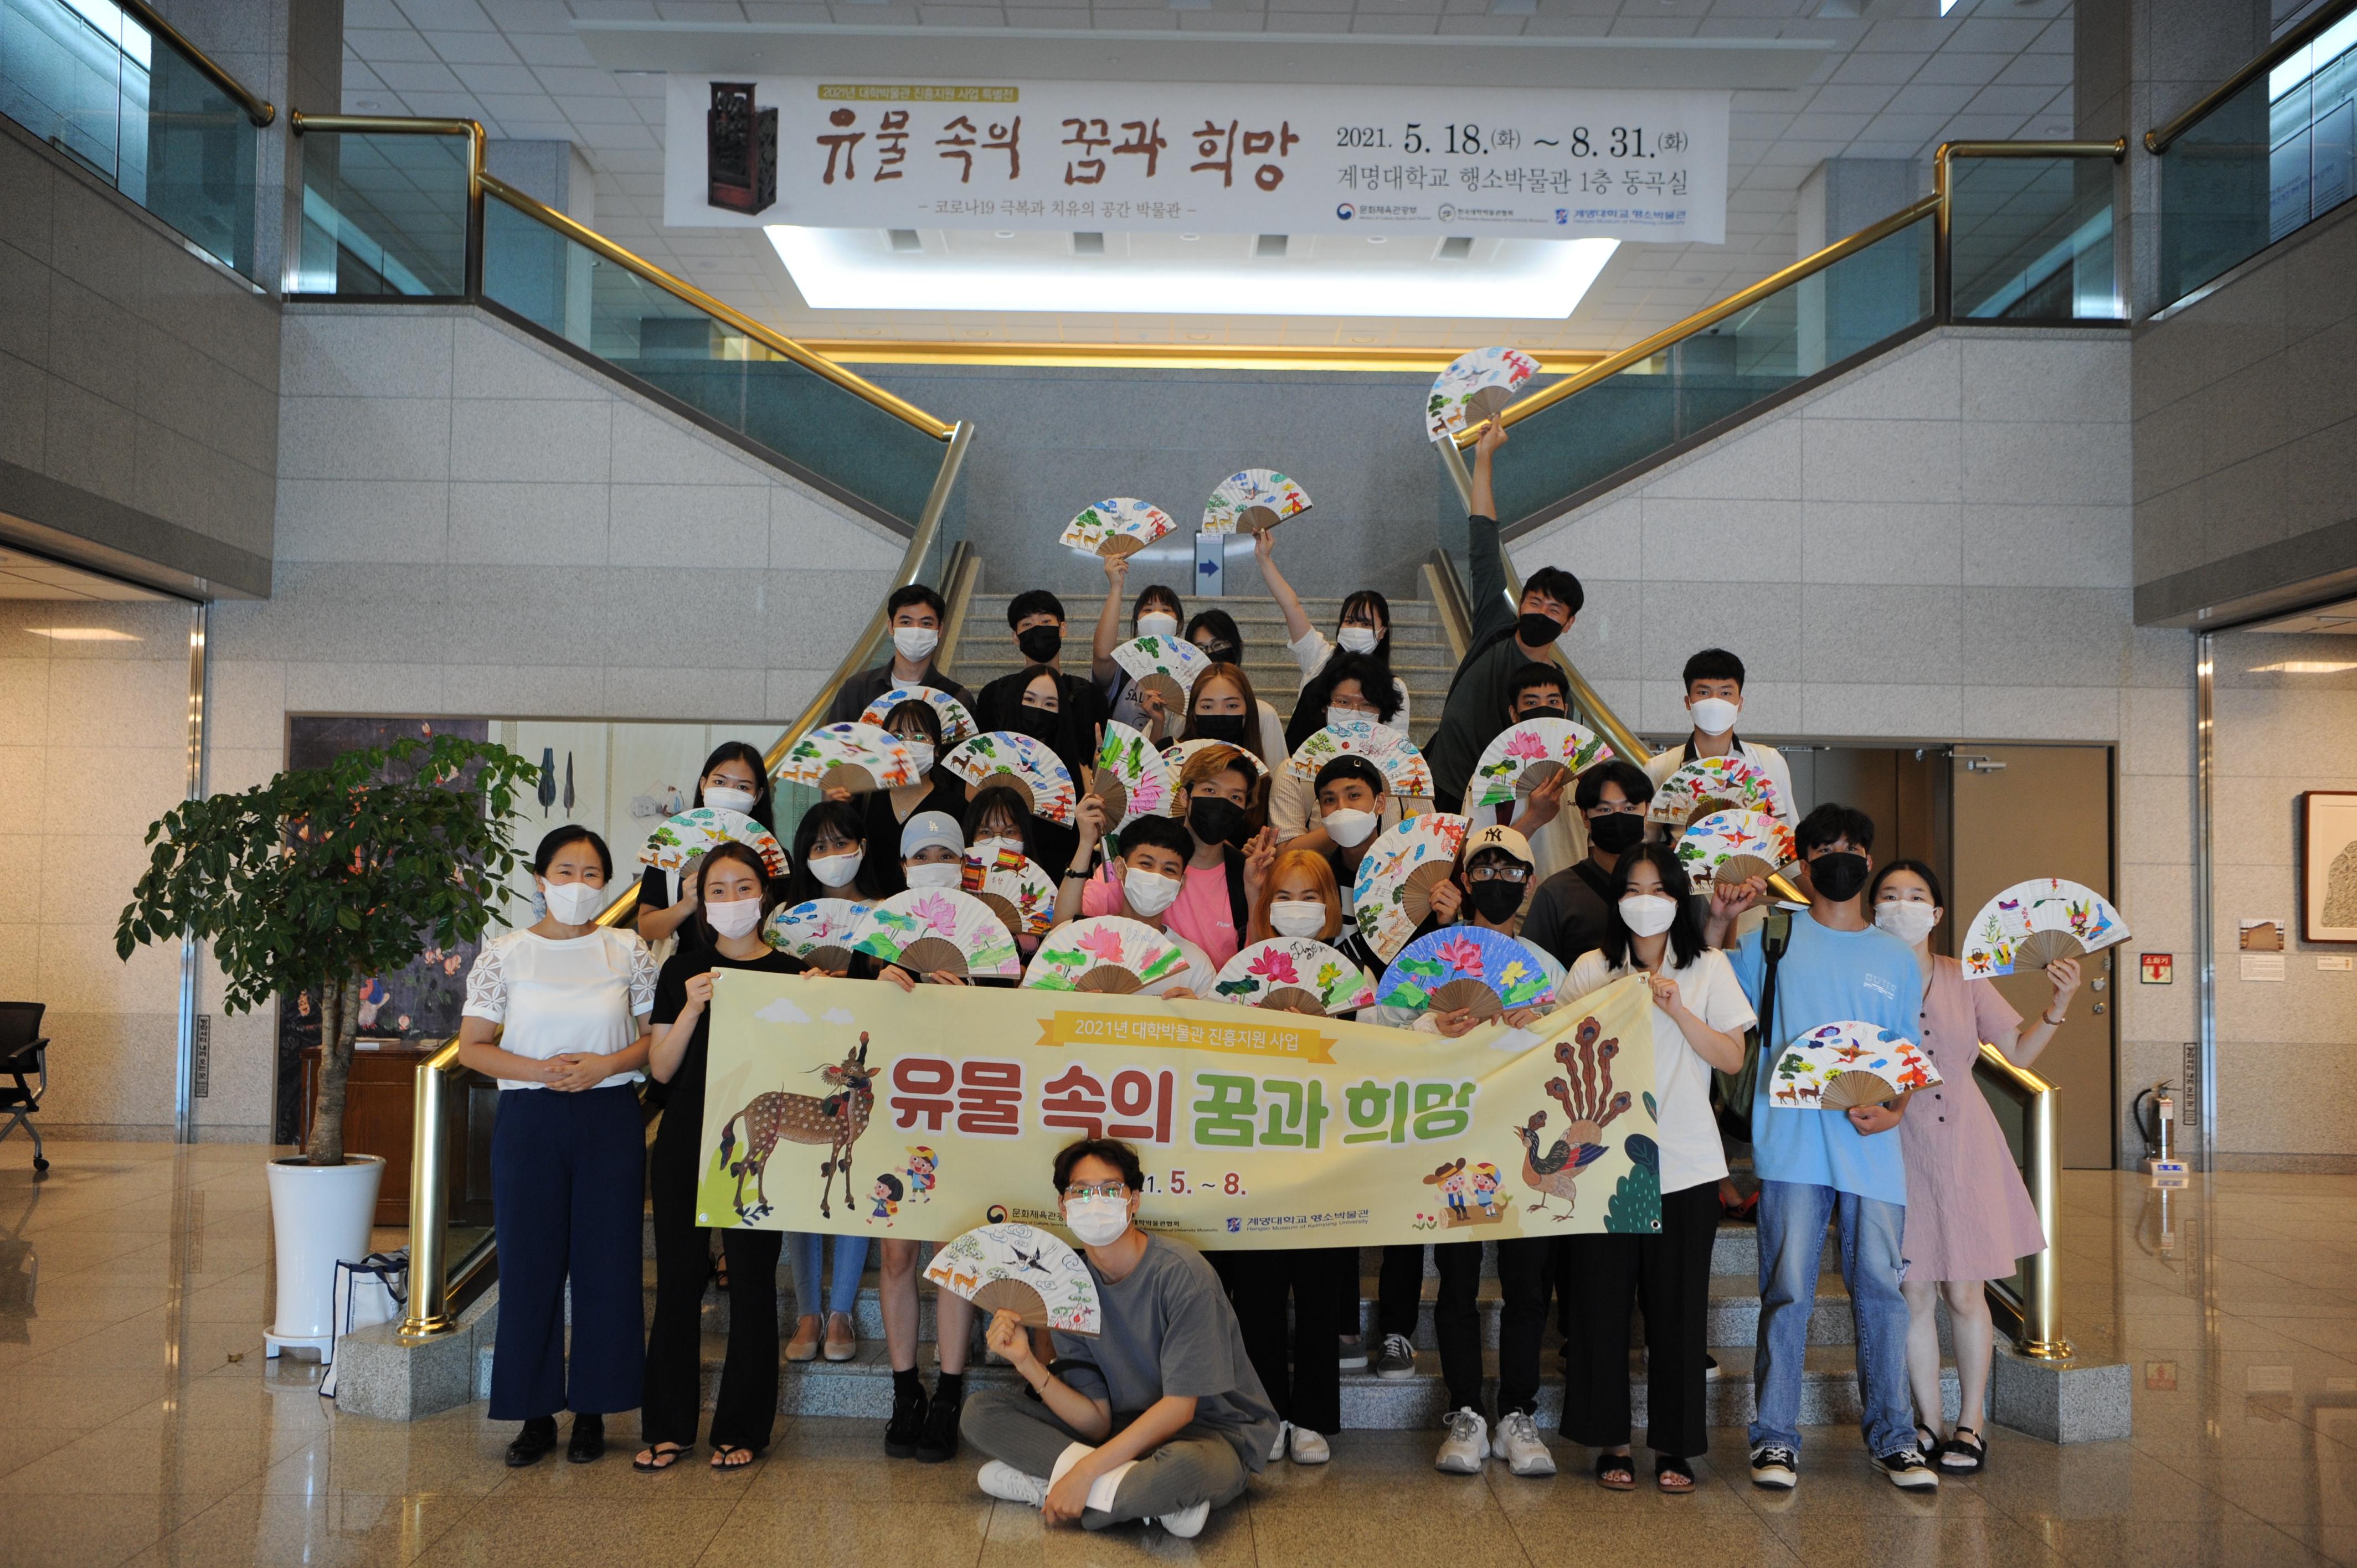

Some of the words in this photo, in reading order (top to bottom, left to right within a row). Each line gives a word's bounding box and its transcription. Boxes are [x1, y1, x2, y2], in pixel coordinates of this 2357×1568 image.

[817, 109, 909, 184] 유물
[936, 116, 1021, 183] 속의
[1062, 117, 1167, 185] 꿈과
[1190, 119, 1300, 192] 희망
[1337, 127, 1392, 148] 2021.
[1404, 123, 1431, 154] 5.
[1571, 126, 1598, 158] 8.
[1337, 164, 1450, 192] 계명대학교
[1460, 166, 1572, 194] 행소박물관
[1581, 169, 1613, 195] 1층
[1622, 169, 1688, 196] 동곡실
[934, 200, 995, 215] 코로나19
[1000, 200, 1045, 216] 극복과
[1051, 201, 1095, 218] 치유의
[1100, 202, 1130, 218] 공간
[1136, 202, 1182, 219] 박물관
[1125, 689, 1143, 704] SAL
[929, 821, 939, 831] LA
[1074, 1019, 1128, 1039] 2021년
[1132, 1022, 1205, 1044] 대학박물관
[1208, 1028, 1266, 1050] 진흥지원
[1269, 1033, 1299, 1051] 사업
[891, 1058, 1022, 1135] 유물
[1042, 1065, 1174, 1143] 속의
[1193, 1074, 1329, 1149] 꿈과
[1343, 1080, 1477, 1144] 희망
[1171, 1170, 1191, 1195] 5.
[1224, 1173, 1246, 1195] 8.
[1012, 1208, 1063, 1221] 문화체육관광
[1247, 1215, 1308, 1226] 계명대학교
[1311, 1209, 1369, 1222] 행소박물관
